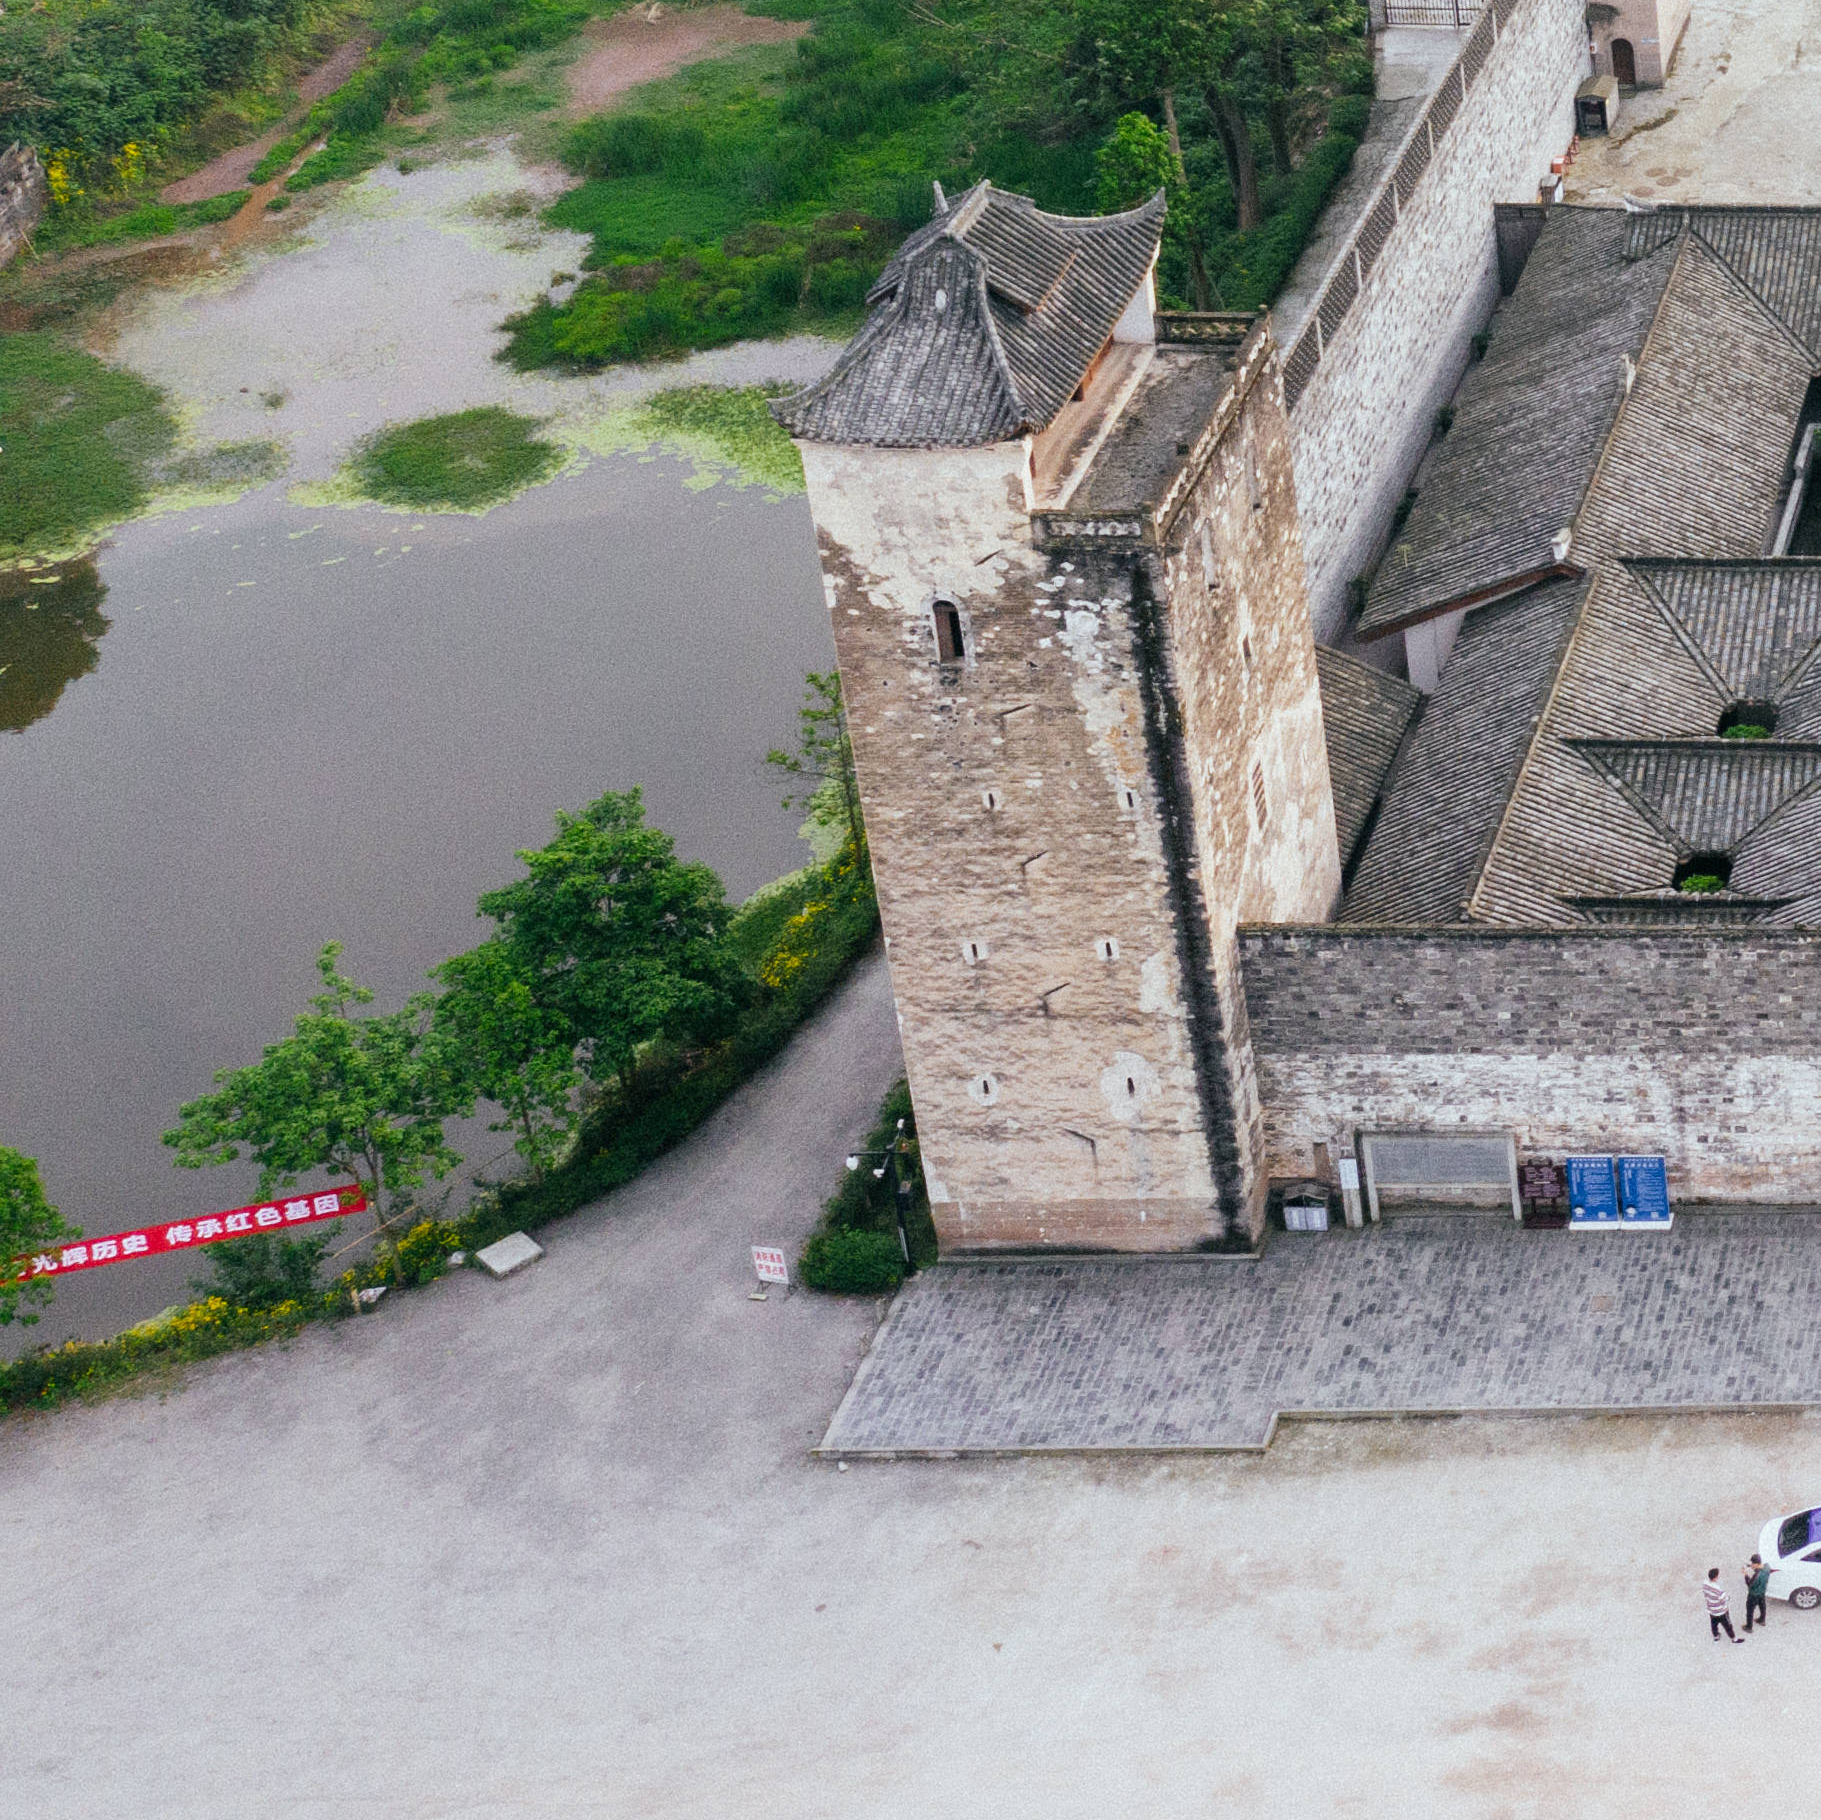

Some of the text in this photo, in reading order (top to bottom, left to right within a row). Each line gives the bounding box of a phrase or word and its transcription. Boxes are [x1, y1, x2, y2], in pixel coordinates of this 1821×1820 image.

[17, 1194, 340, 1277] 光辉历史 传承红色基因
